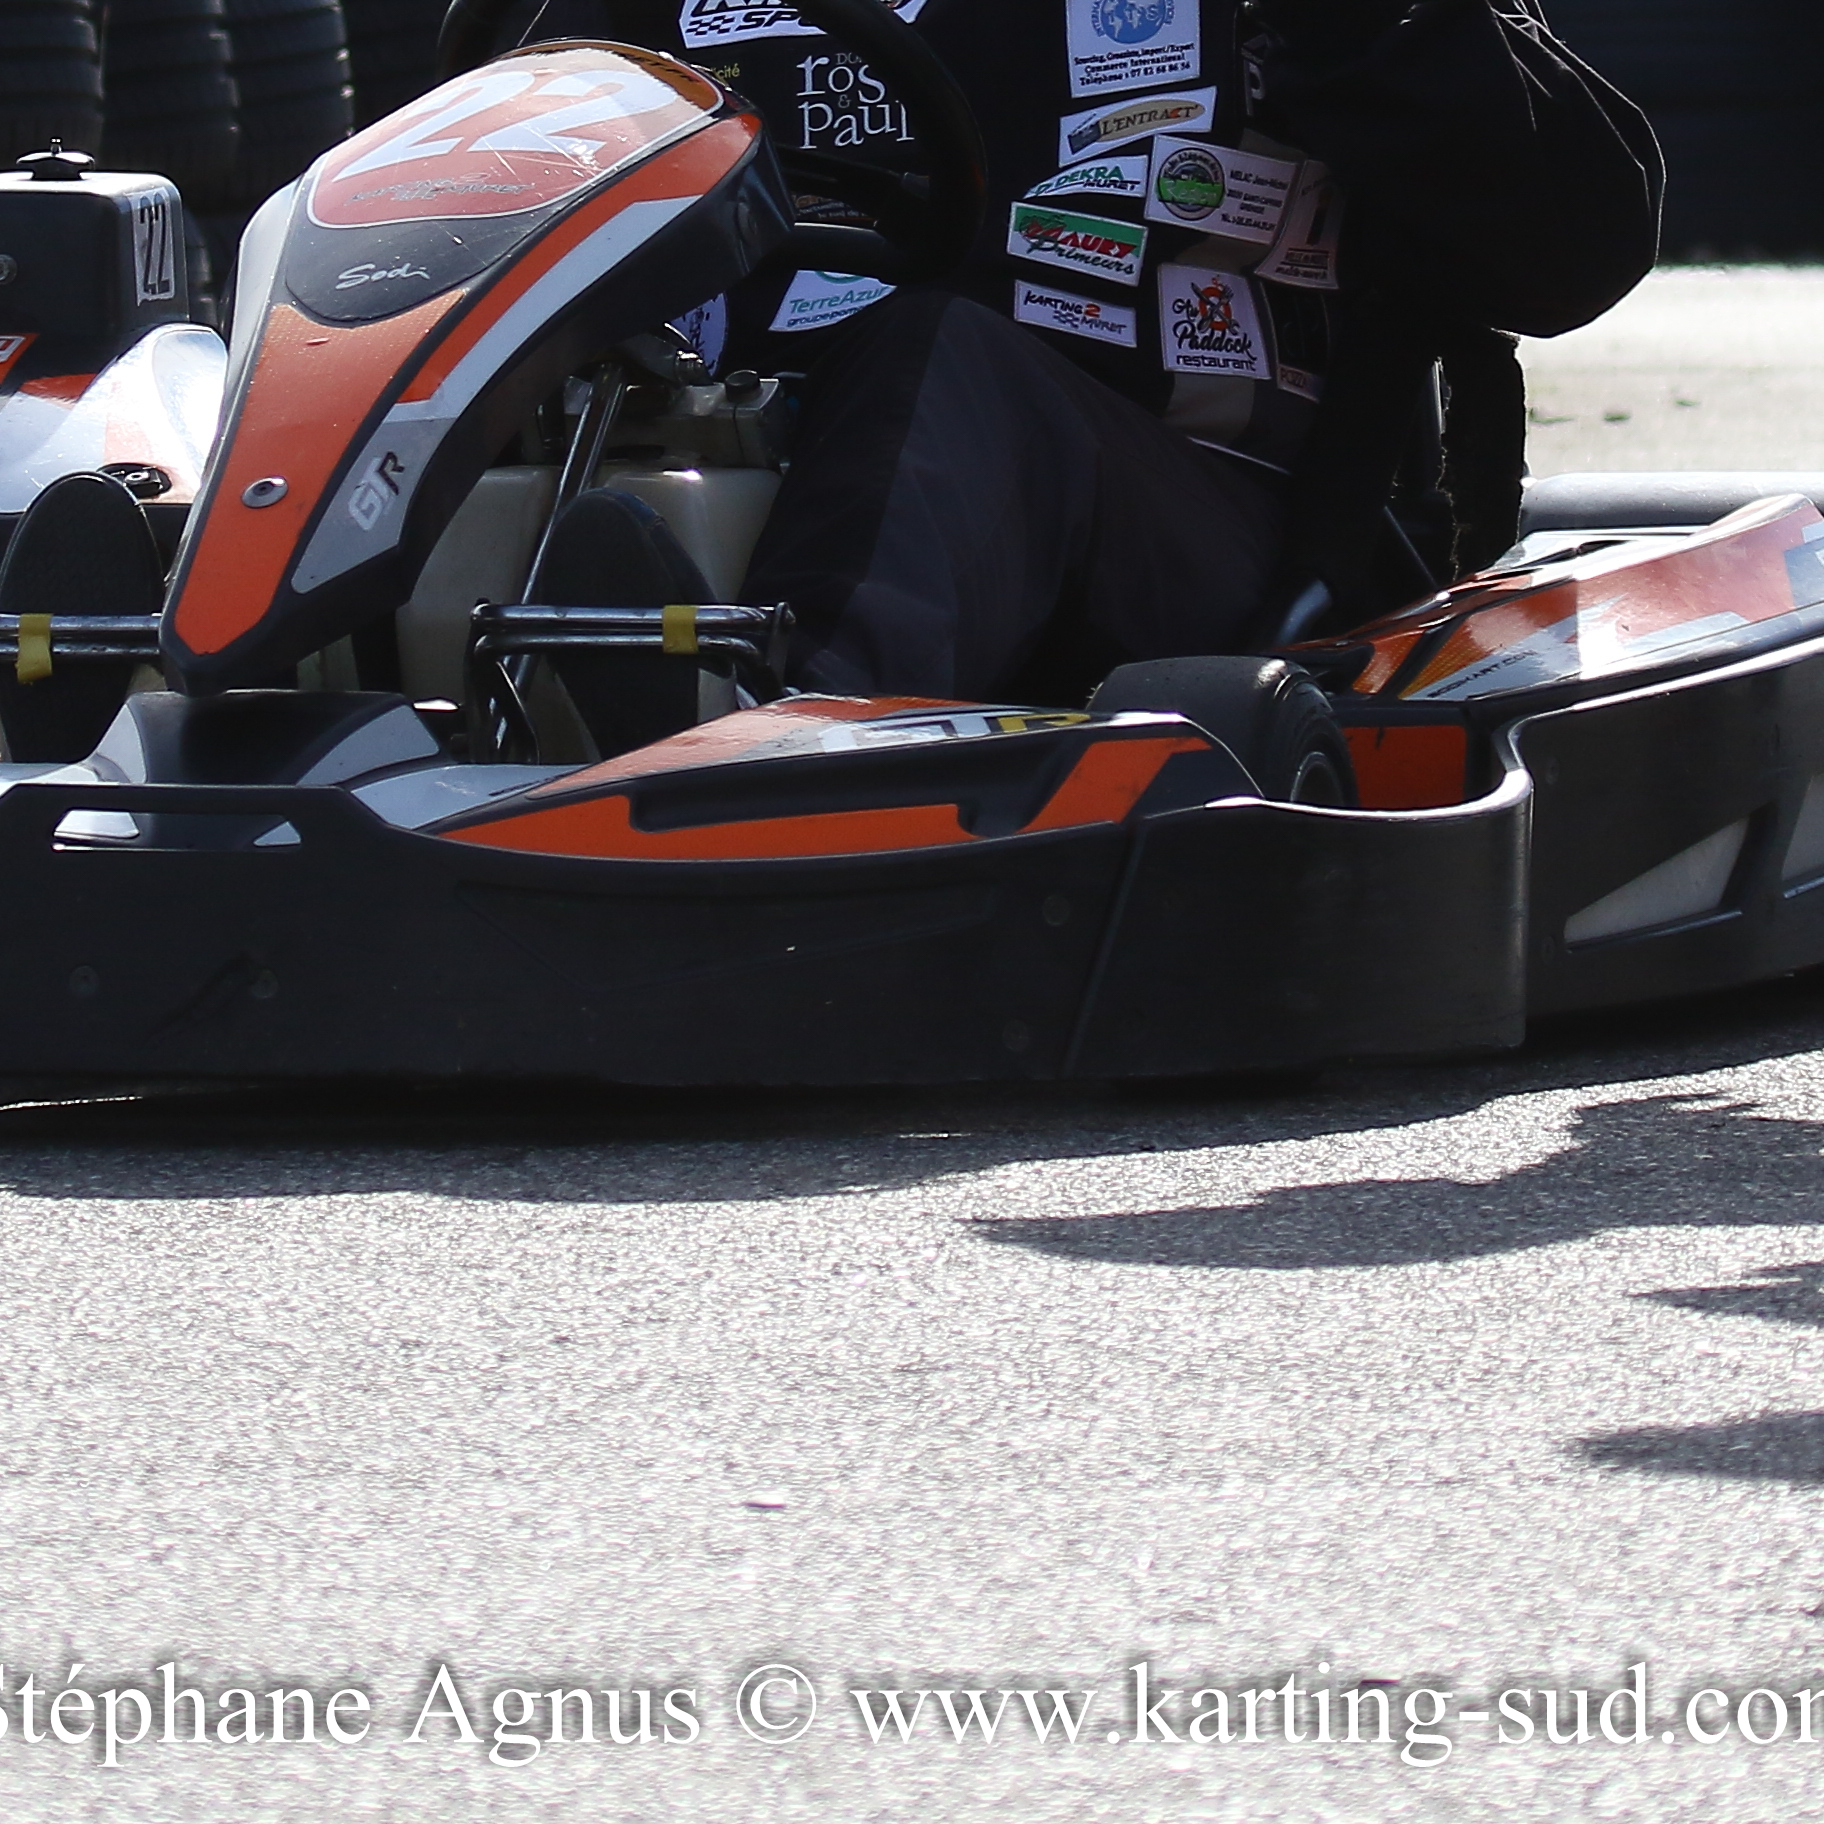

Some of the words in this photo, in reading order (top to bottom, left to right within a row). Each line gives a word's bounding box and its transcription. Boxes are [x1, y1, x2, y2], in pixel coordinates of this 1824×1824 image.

[1085, 61, 1128, 75] Commerce
[1130, 52, 1186, 68] International
[838, 95, 852, 108] &
[333, 71, 679, 182] 22
[1055, 166, 1125, 189] DEKRA
[1083, 179, 1140, 191] MURET
[138, 192, 171, 296] 22
[1027, 236, 1135, 275] Primeurs
[335, 263, 430, 290] Sodi
[790, 286, 889, 314] TerreAzur
[1025, 291, 1083, 315] KARTING
[1084, 303, 1101, 318] 2
[1081, 317, 1126, 335] MURET
[1173, 320, 1257, 361] Paddock
[1176, 354, 1257, 372] restaurant
[348, 451, 405, 531] GTR
